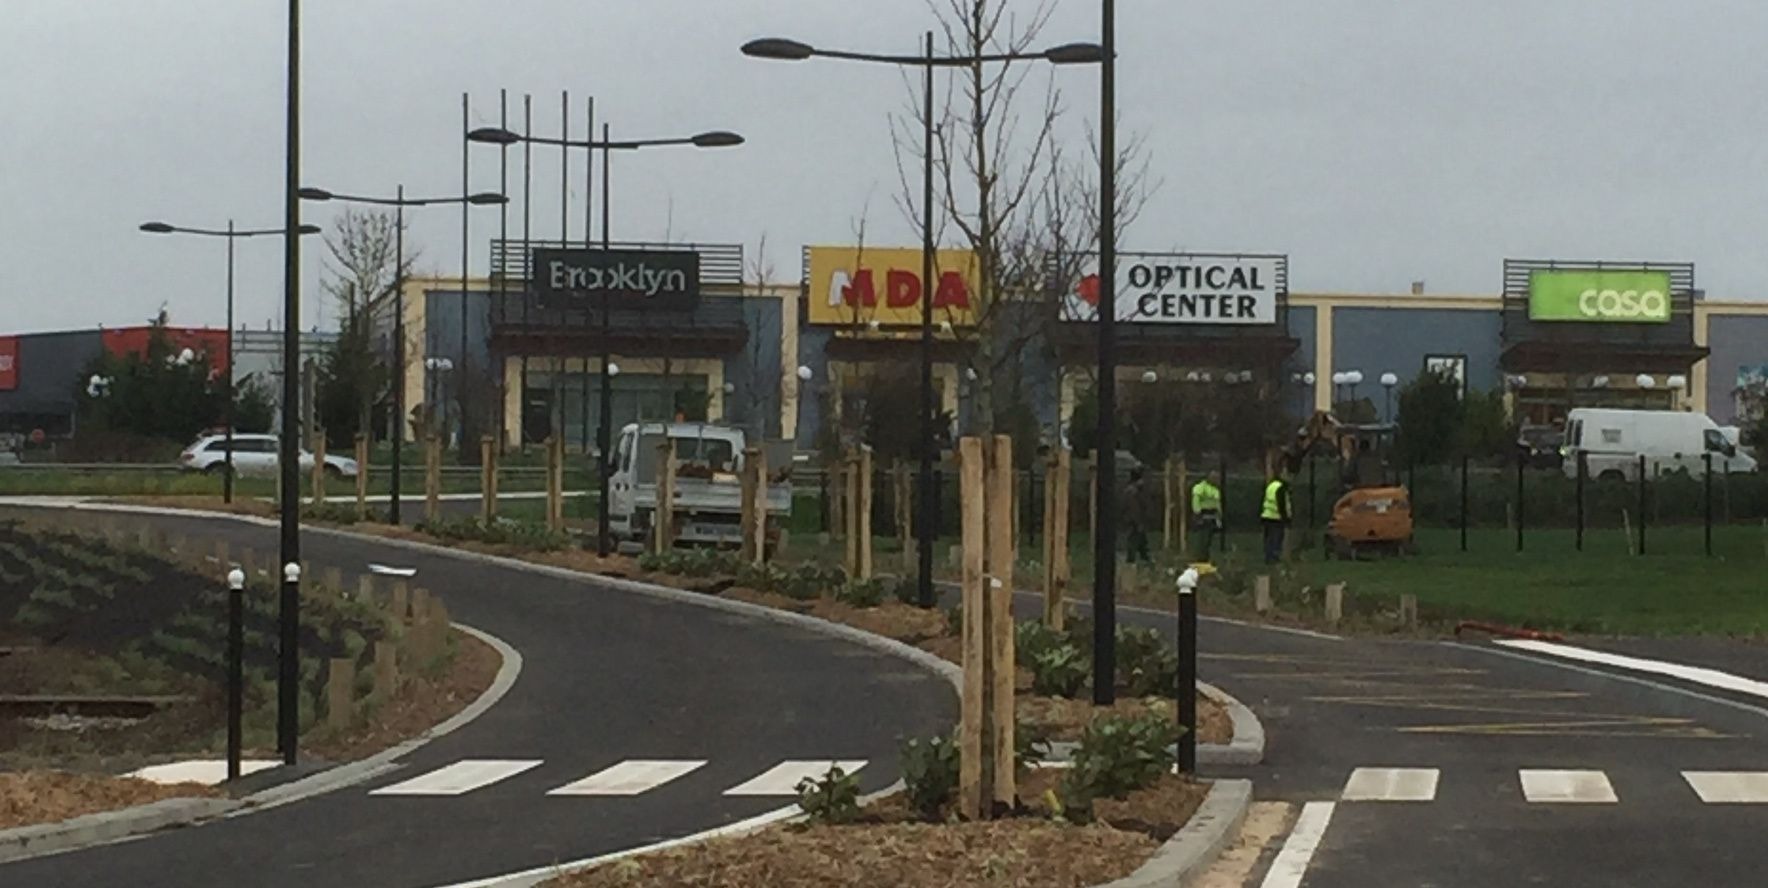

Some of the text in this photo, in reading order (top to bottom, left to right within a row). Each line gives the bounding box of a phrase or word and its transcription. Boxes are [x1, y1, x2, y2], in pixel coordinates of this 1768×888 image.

[828, 269, 970, 308] MDA
[1129, 264, 1265, 290] OPTICAL
[1138, 293, 1257, 318] CENTER
[1579, 289, 1666, 317] casa
